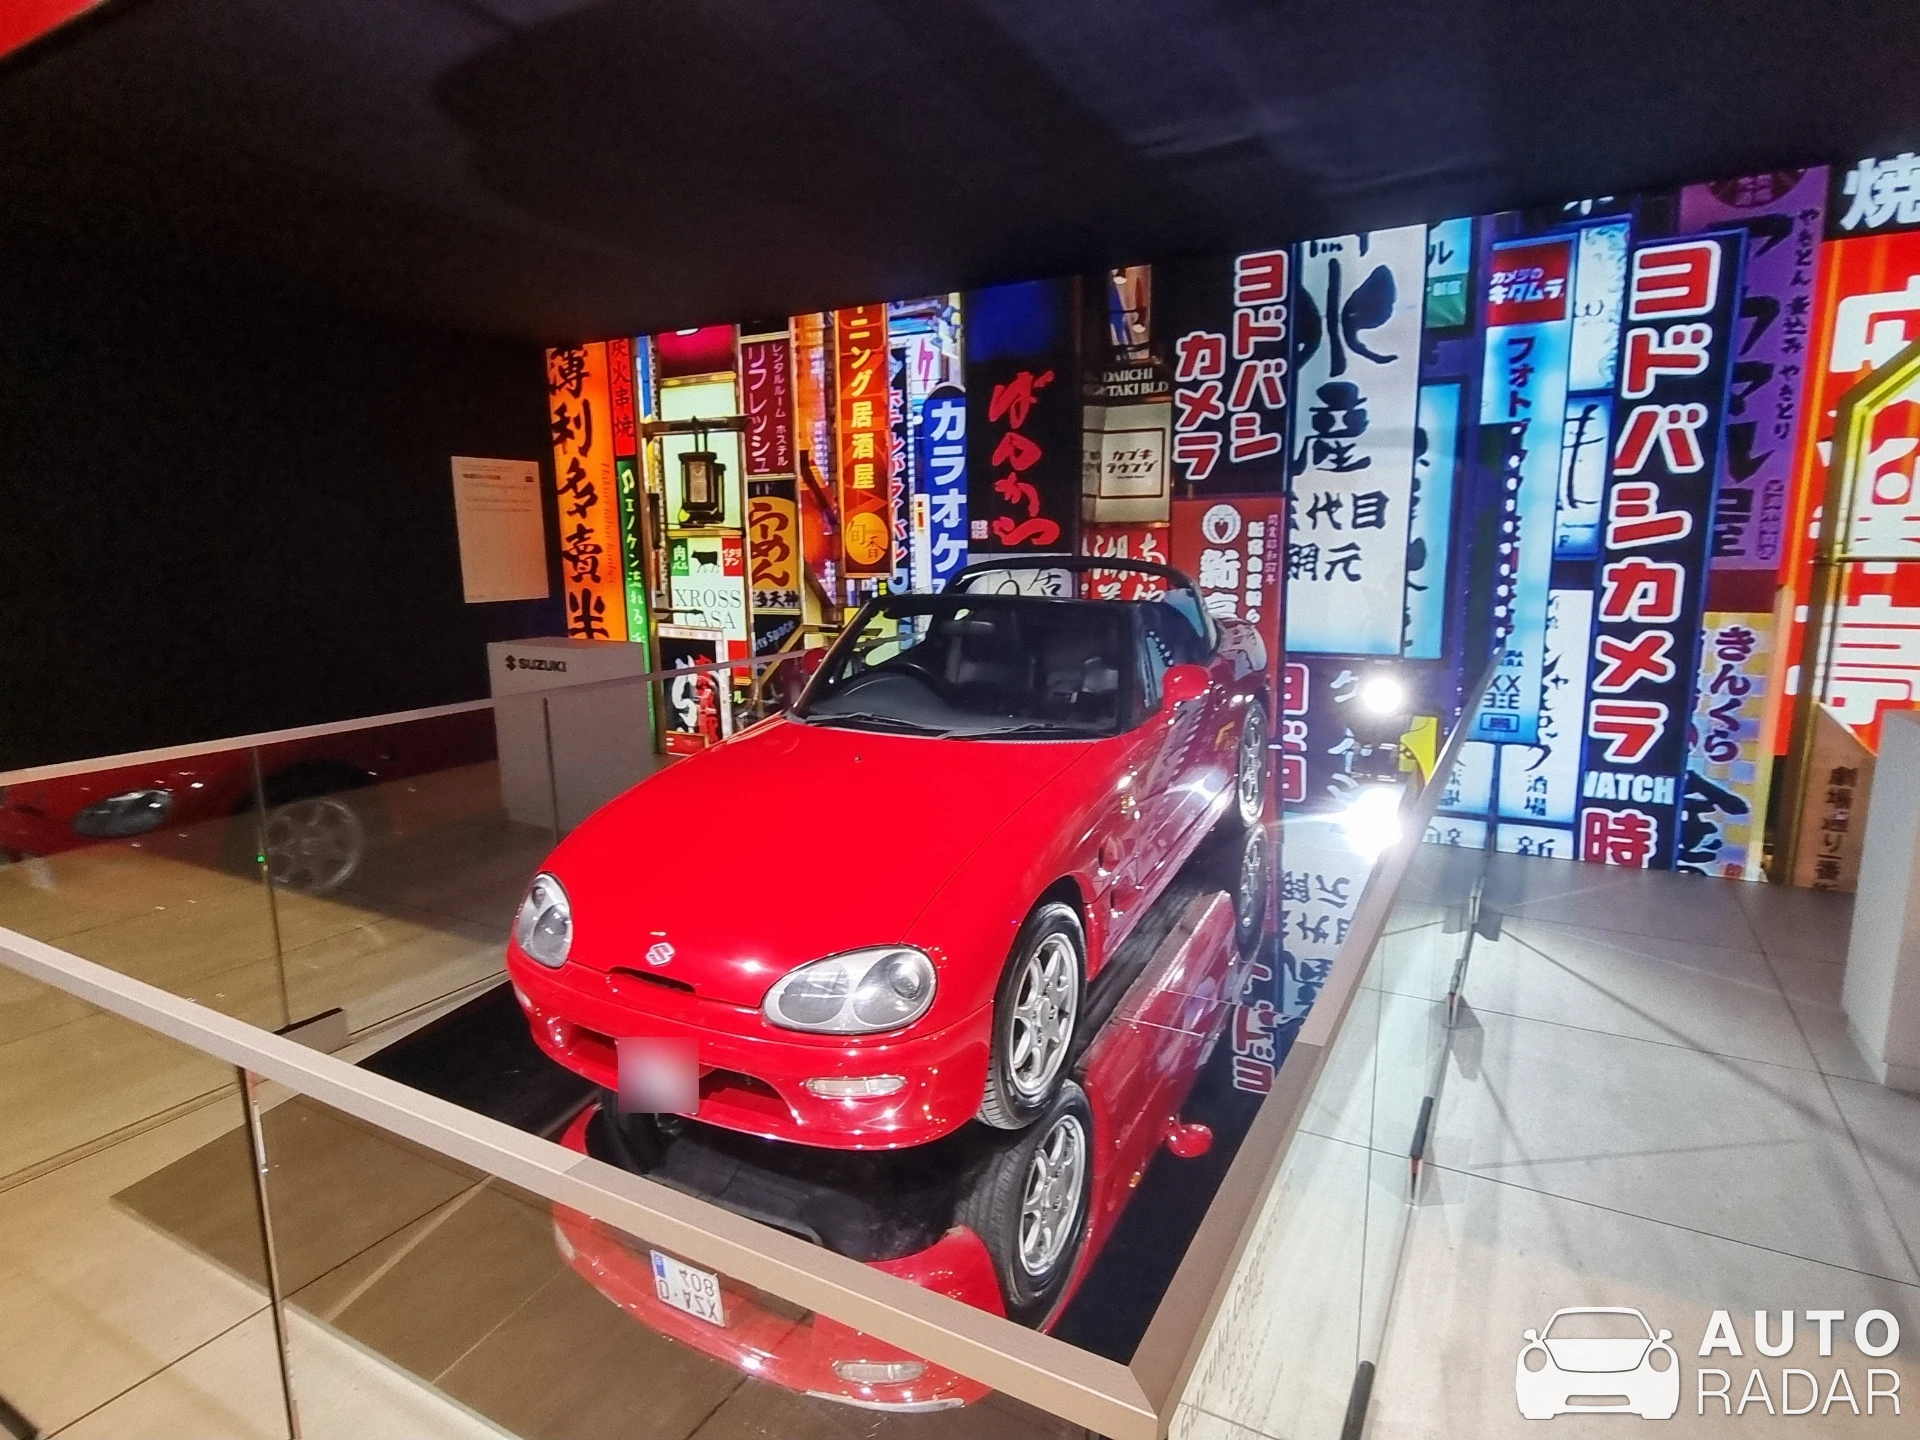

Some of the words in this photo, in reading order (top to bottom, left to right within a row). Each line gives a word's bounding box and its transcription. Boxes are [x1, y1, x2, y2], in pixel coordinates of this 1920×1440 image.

[1488, 278, 1565, 305] キタムラ
[748, 344, 771, 473] リフレッシュ
[848, 306, 876, 490] ニング居酒屋
[1173, 331, 1226, 480] カメラ
[1228, 250, 1289, 463] ヨドバシ
[750, 501, 791, 588] らーめん
[929, 400, 969, 594] カラオケ
[1588, 239, 1722, 765] ヨドバシカメラ
[674, 588, 742, 608] XROSS
[684, 611, 737, 630] CASA
[753, 590, 800, 608] 多天神
[518, 657, 567, 673] SUZUKI
[1703, 623, 1756, 763] きんくら
